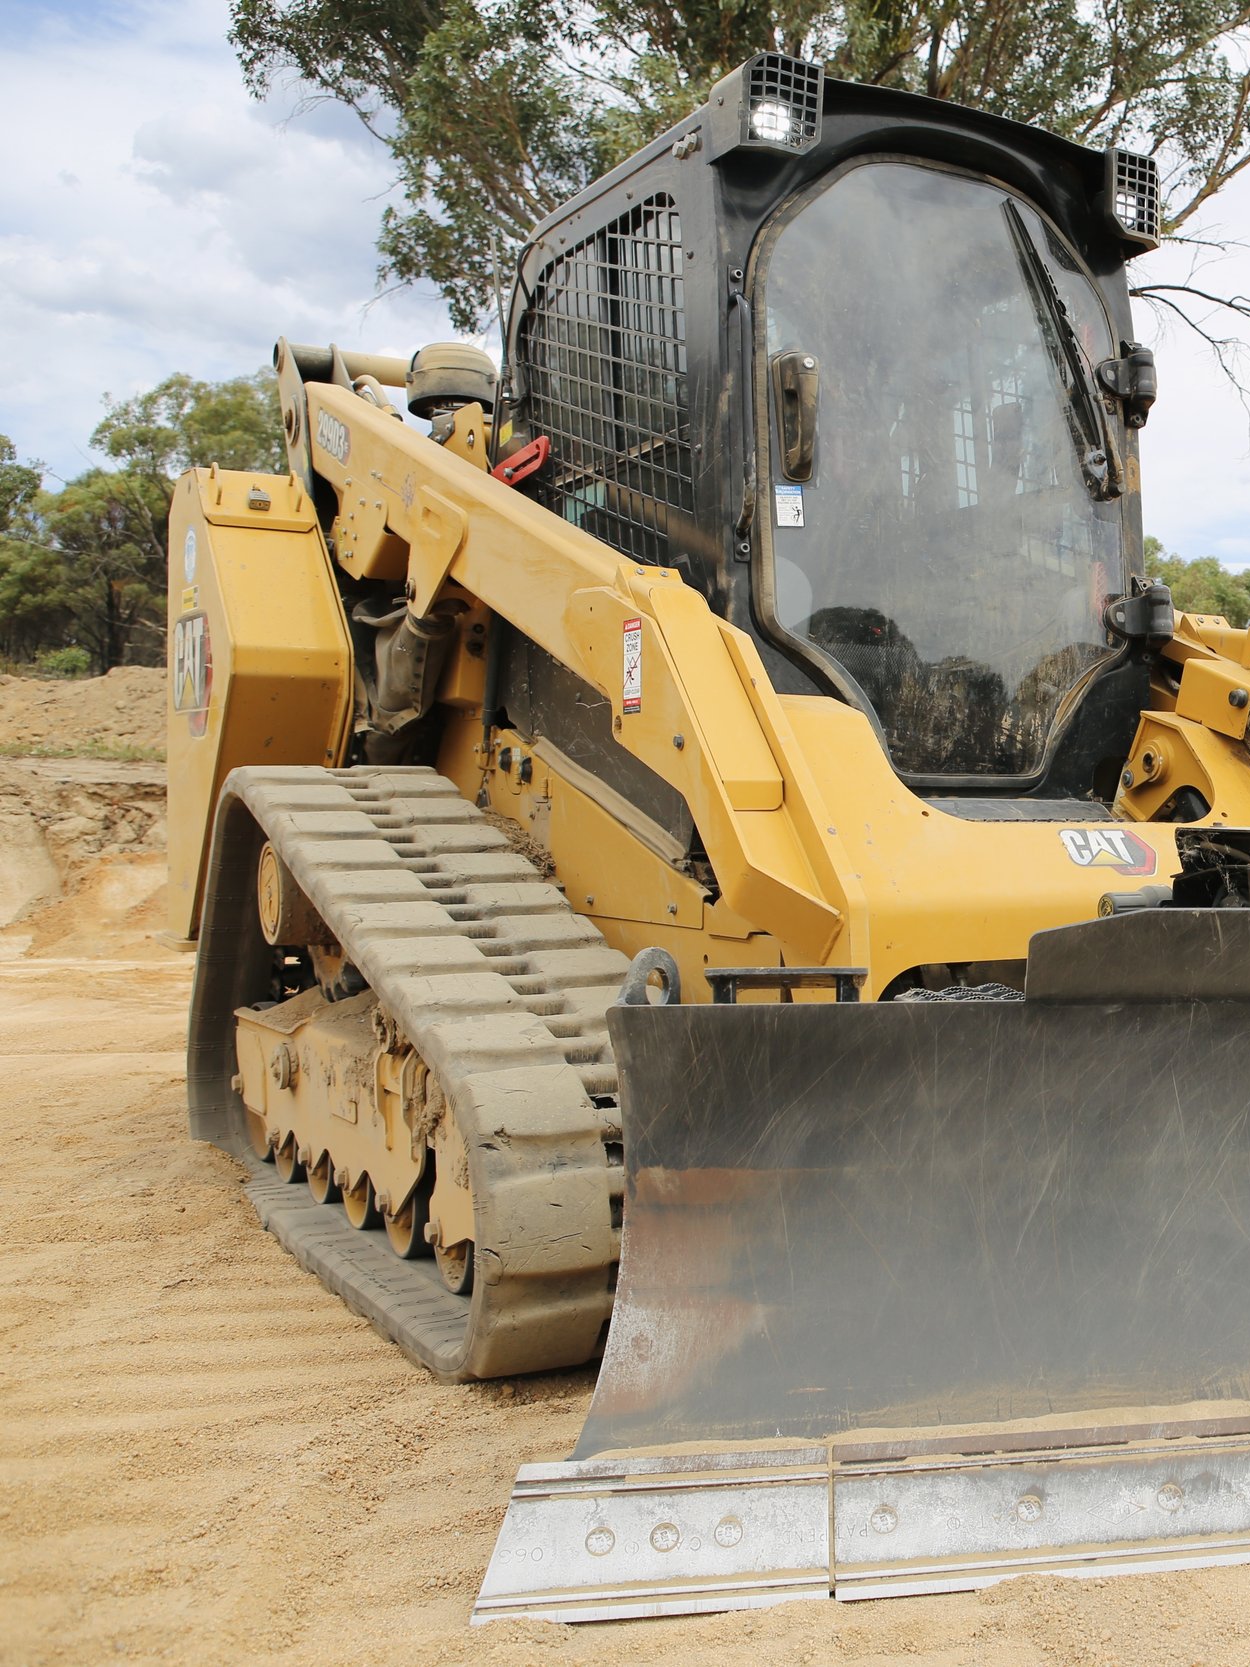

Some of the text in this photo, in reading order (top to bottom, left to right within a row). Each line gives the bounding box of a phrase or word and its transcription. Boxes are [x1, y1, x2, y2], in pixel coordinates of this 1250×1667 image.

[625, 632, 640, 642] CRUSH
[626, 642, 639, 653] ZONE
[175, 617, 204, 709] CAT
[1060, 830, 1134, 865] CAT
